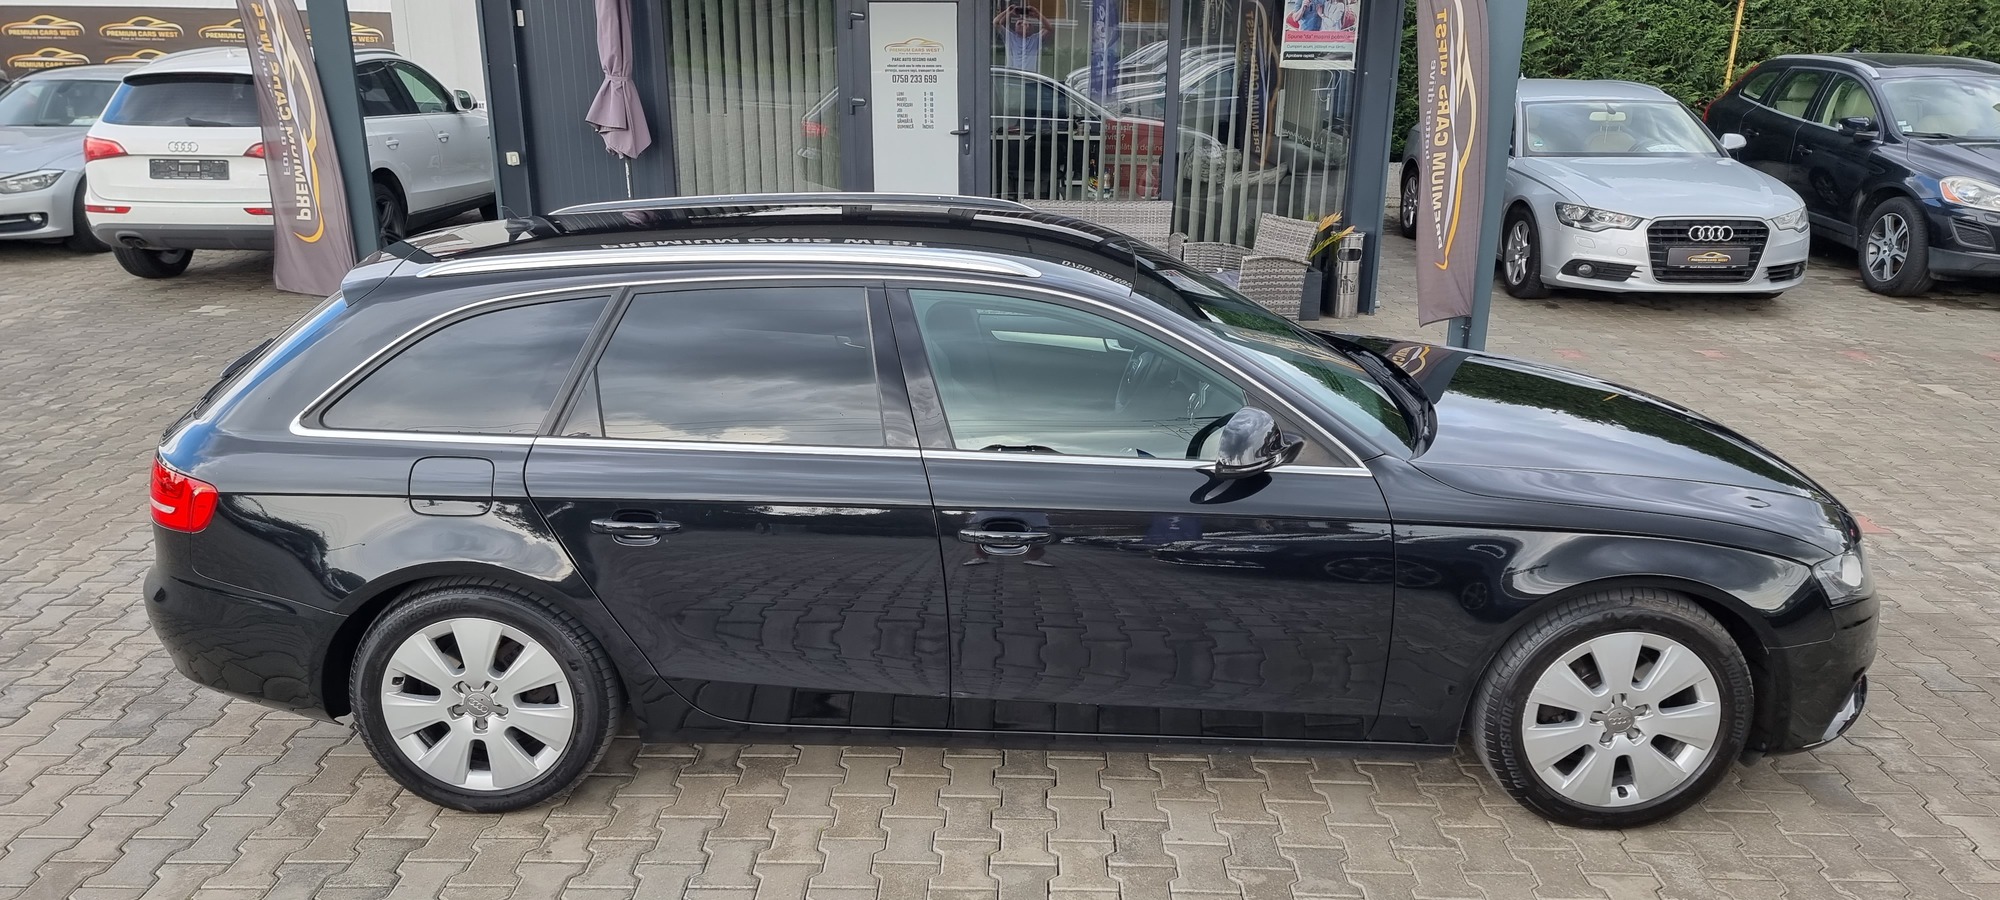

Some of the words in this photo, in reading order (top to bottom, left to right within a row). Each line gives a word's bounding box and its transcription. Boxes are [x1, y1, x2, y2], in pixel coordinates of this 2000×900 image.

[891, 75, 909, 83] 0758
[910, 75, 922, 83] 233
[924, 75, 937, 83] 699
